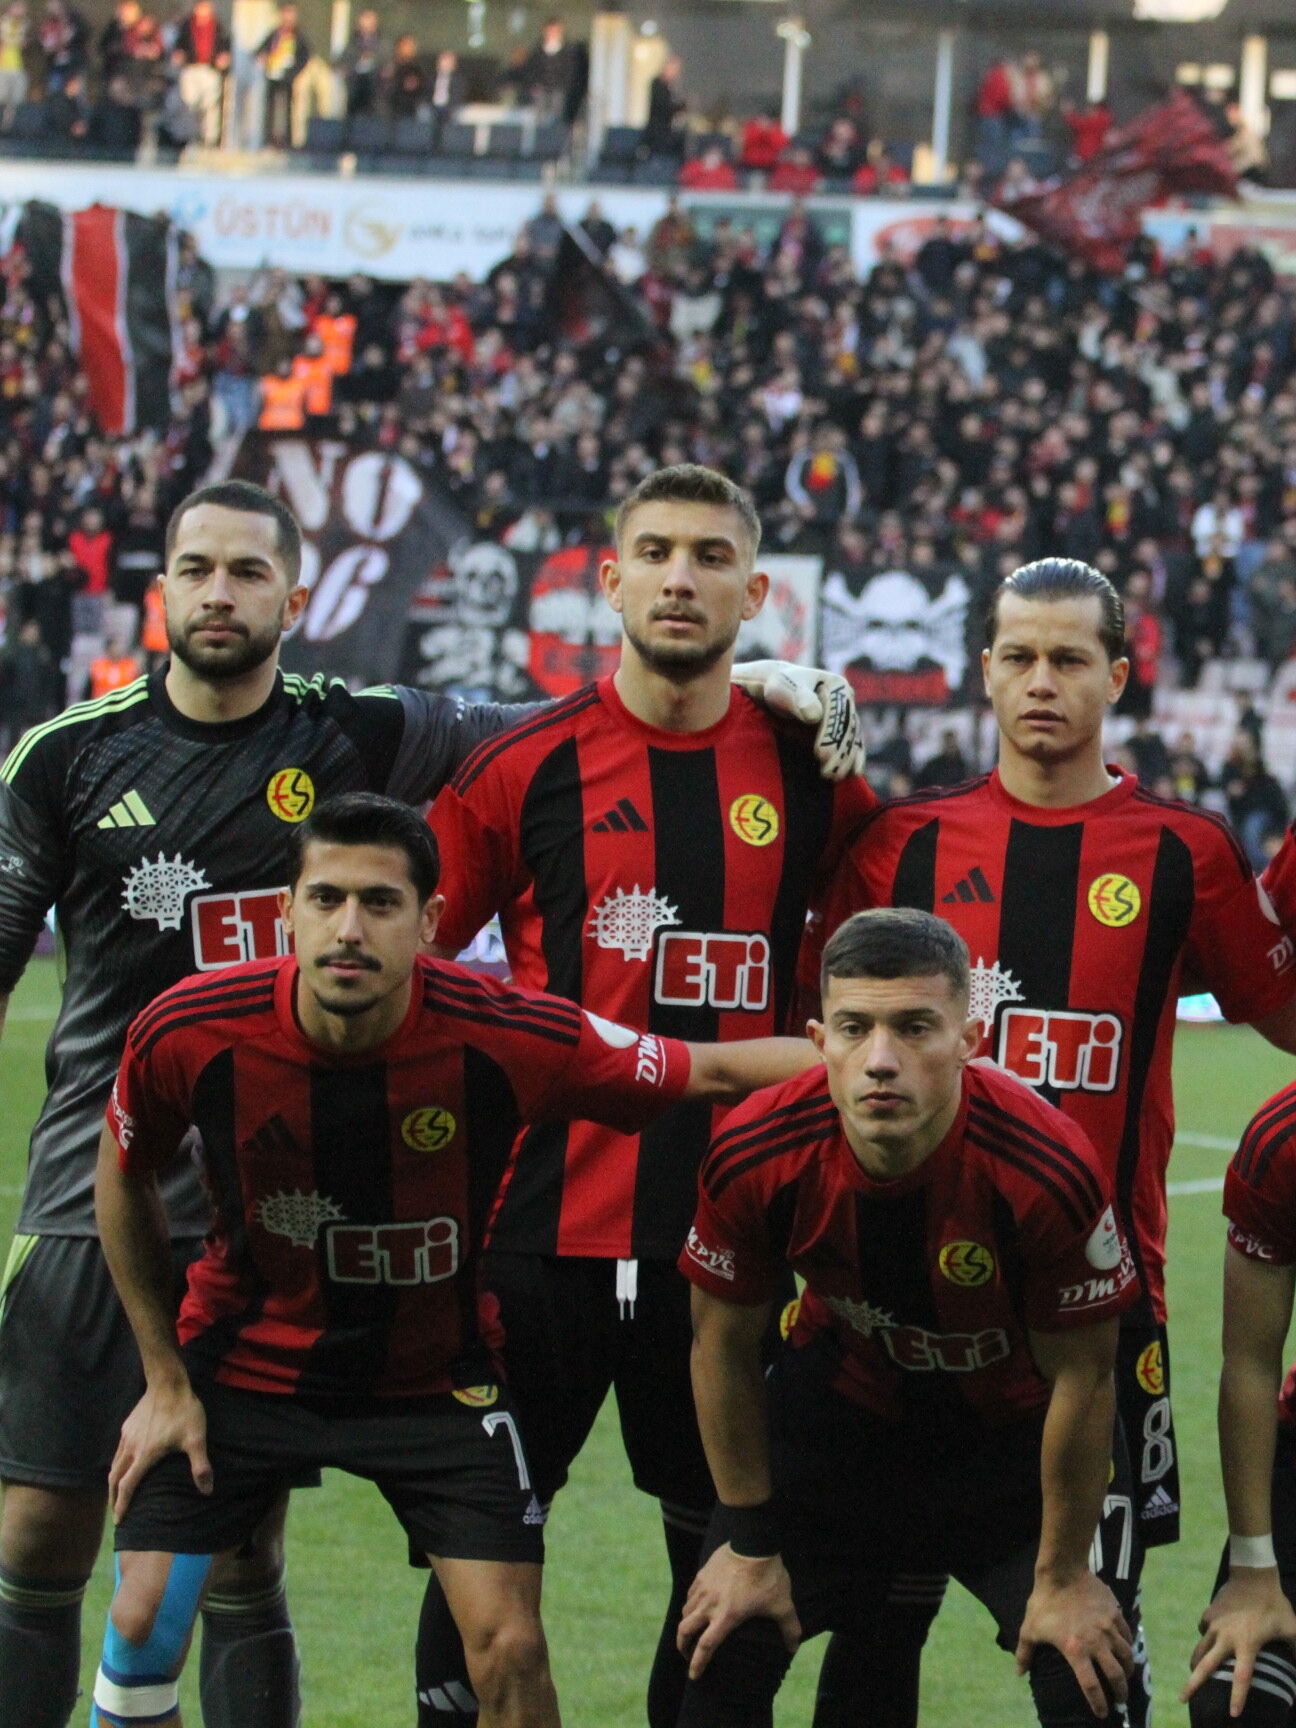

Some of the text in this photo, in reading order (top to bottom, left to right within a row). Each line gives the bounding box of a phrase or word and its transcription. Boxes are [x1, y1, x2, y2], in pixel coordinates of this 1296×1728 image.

[191, 886, 296, 972] ET
[481, 1410, 531, 1491] 7
[1141, 1396, 1174, 1484] 8
